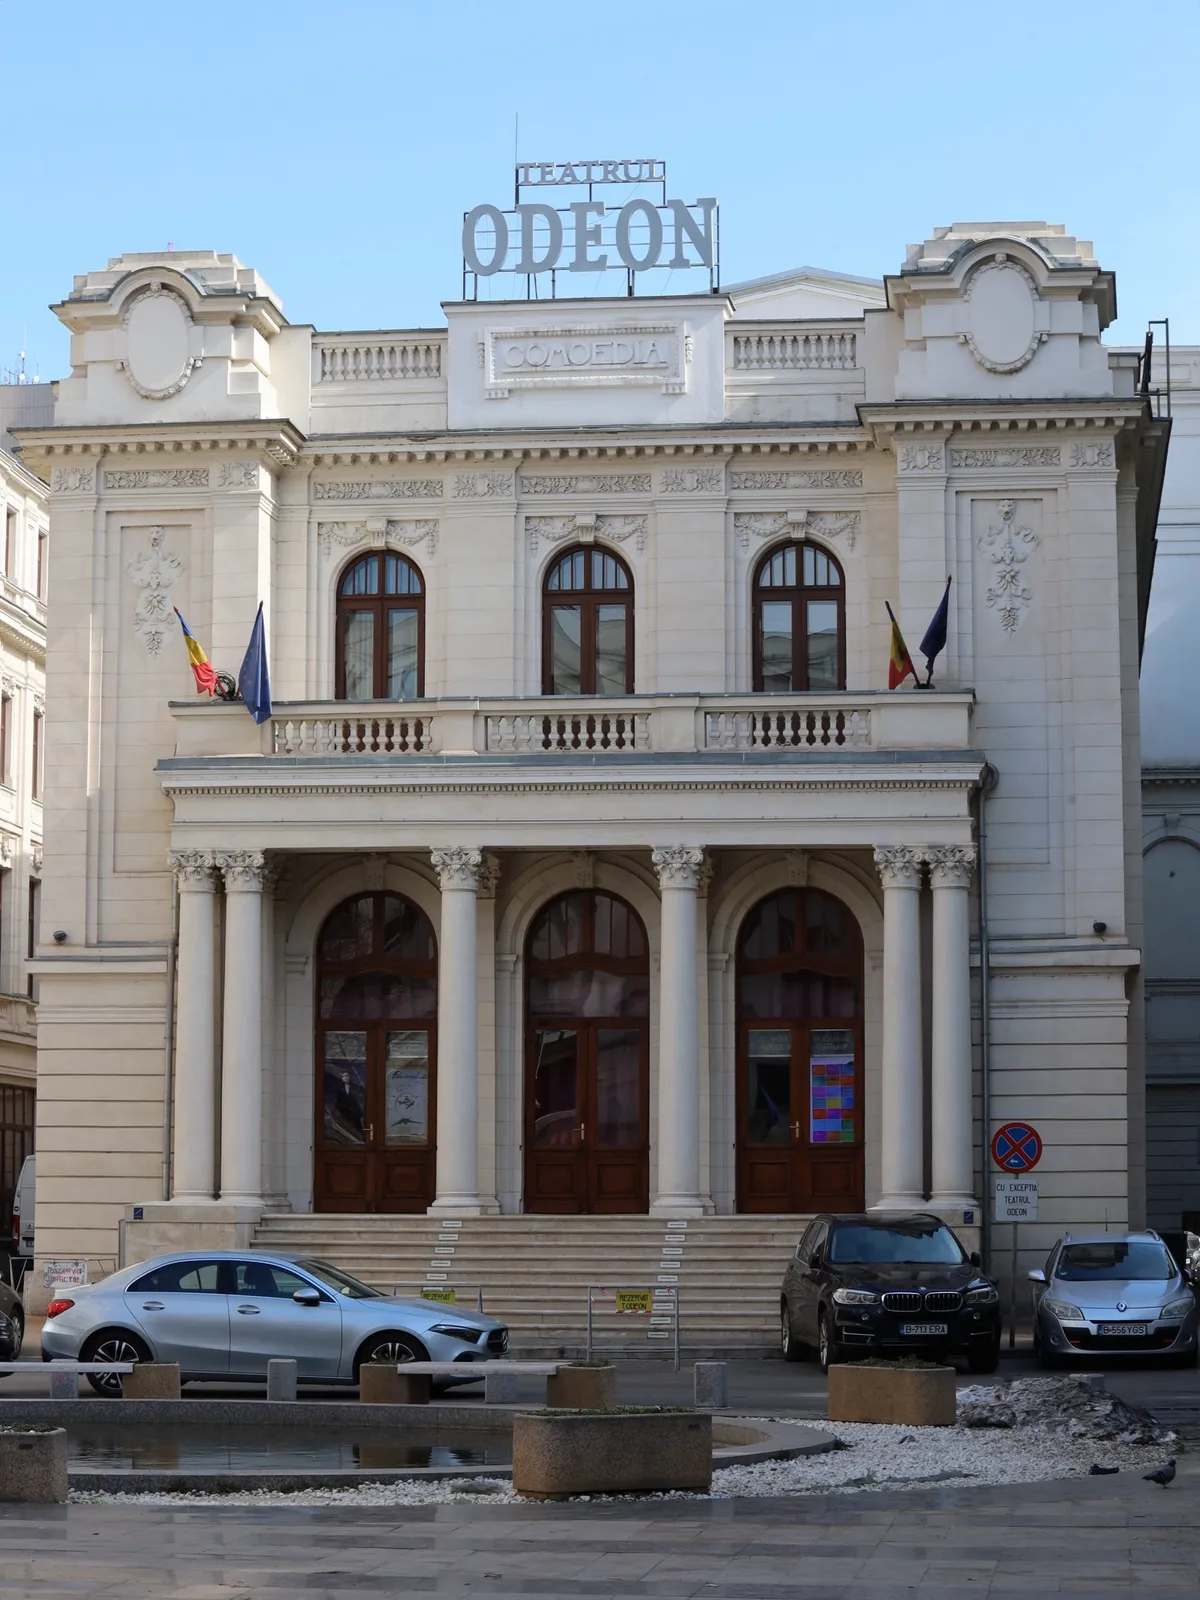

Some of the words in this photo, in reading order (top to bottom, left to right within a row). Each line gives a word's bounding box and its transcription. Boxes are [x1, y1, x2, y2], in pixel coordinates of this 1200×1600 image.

[517, 159, 664, 185] TEATRUL
[462, 197, 718, 277] ODEON
[503, 340, 668, 369] COMOEDIA
[996, 1183, 1005, 1192] CU
[1004, 1195, 1031, 1204] TEATRUL
[1006, 1207, 1028, 1216] ODEON
[619, 1294, 649, 1302] REZERVAT
[929, 1325, 946, 1334] ERA
